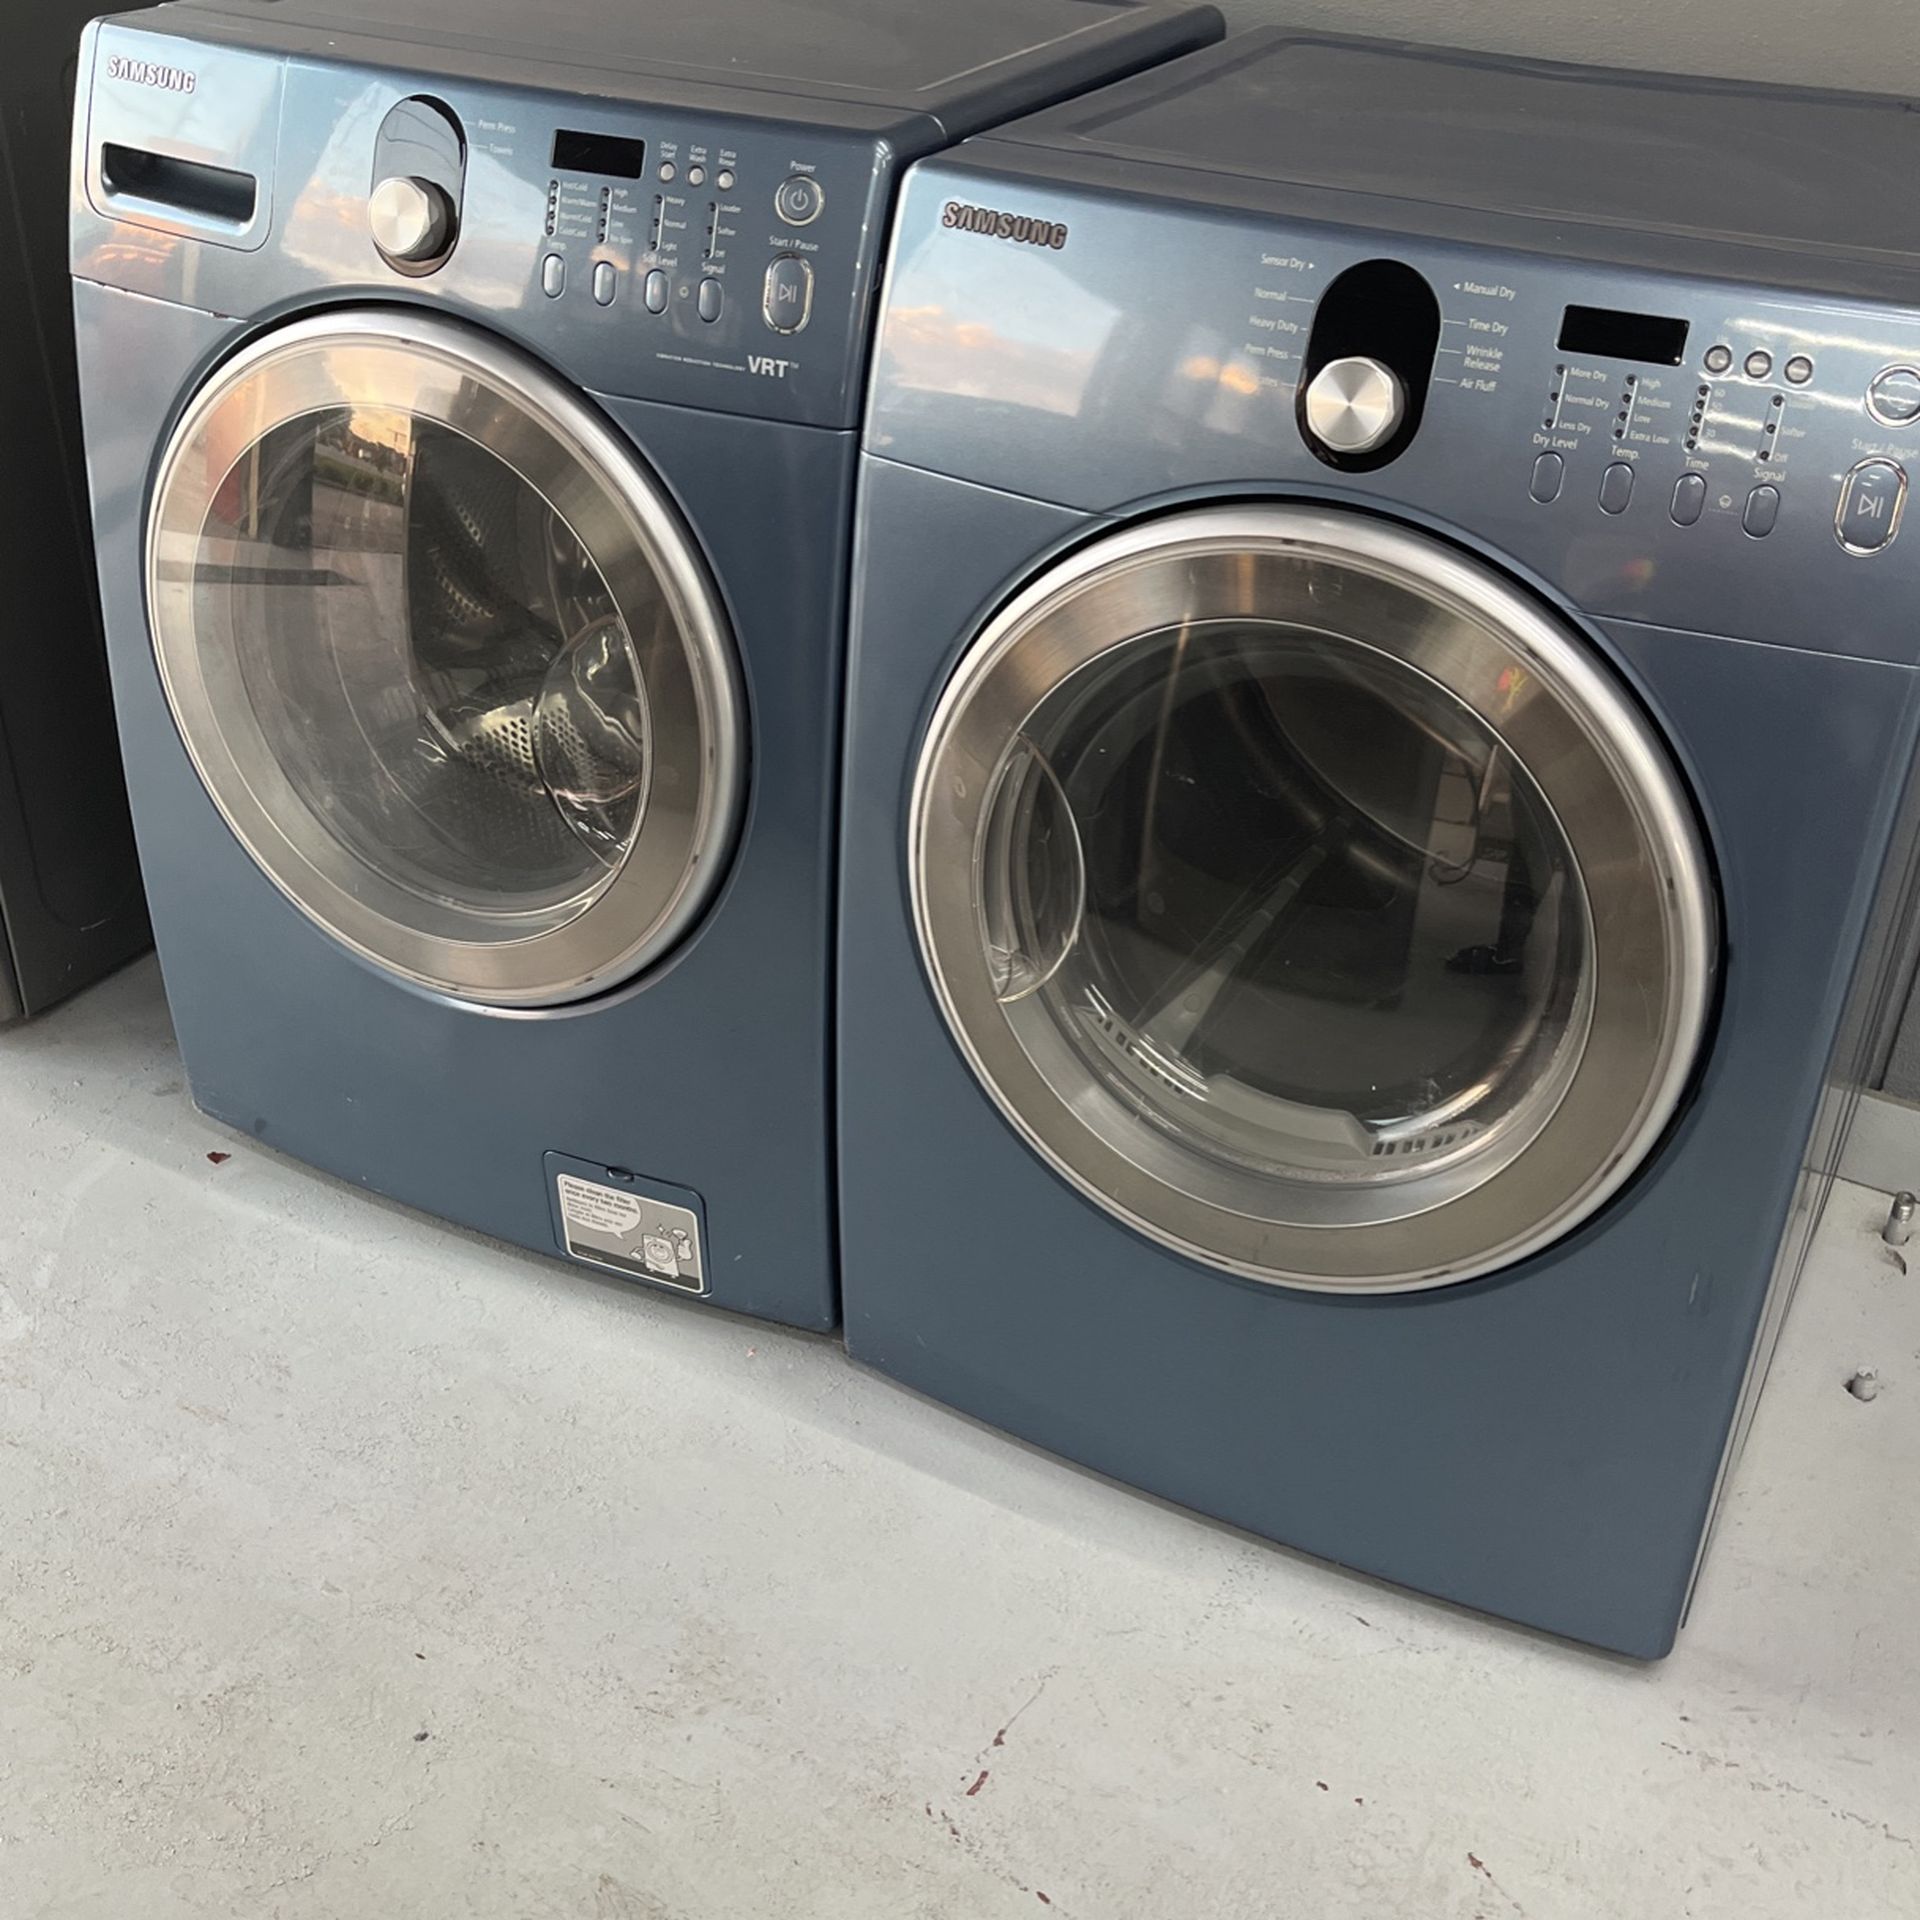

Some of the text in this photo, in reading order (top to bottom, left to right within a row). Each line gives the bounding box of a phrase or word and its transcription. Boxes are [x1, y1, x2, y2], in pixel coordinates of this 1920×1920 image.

[107, 55, 197, 94] SAMSUNG
[790, 160, 816, 173] Power
[942, 201, 1068, 250] SAMSUNG
[769, 235, 788, 247] Start
[794, 239, 819, 252] Pause
[701, 261, 726, 275] Signal
[1261, 253, 1306, 272] Sensor Dry
[1254, 287, 1288, 301] Normal
[1463, 281, 1517, 301] Manual Dry
[1248, 315, 1299, 335] Heavy Duty
[1469, 318, 1510, 337] Time Dry
[1266, 346, 1289, 360] Press
[1466, 344, 1504, 360] Wrinkle
[1463, 356, 1501, 373] Release
[1570, 367, 1608, 383] More Dry
[1459, 378, 1498, 393] Air Fluff
[1565, 394, 1611, 411] Normal Dry
[1637, 396, 1671, 409] Medium
[1633, 413, 1652, 424] Low
[1559, 420, 1593, 435] Less Dry
[1532, 433, 1578, 450] Dry Level
[1629, 430, 1670, 445] Extra Low
[1685, 457, 1711, 471] Time
[1753, 467, 1787, 483] Signal
